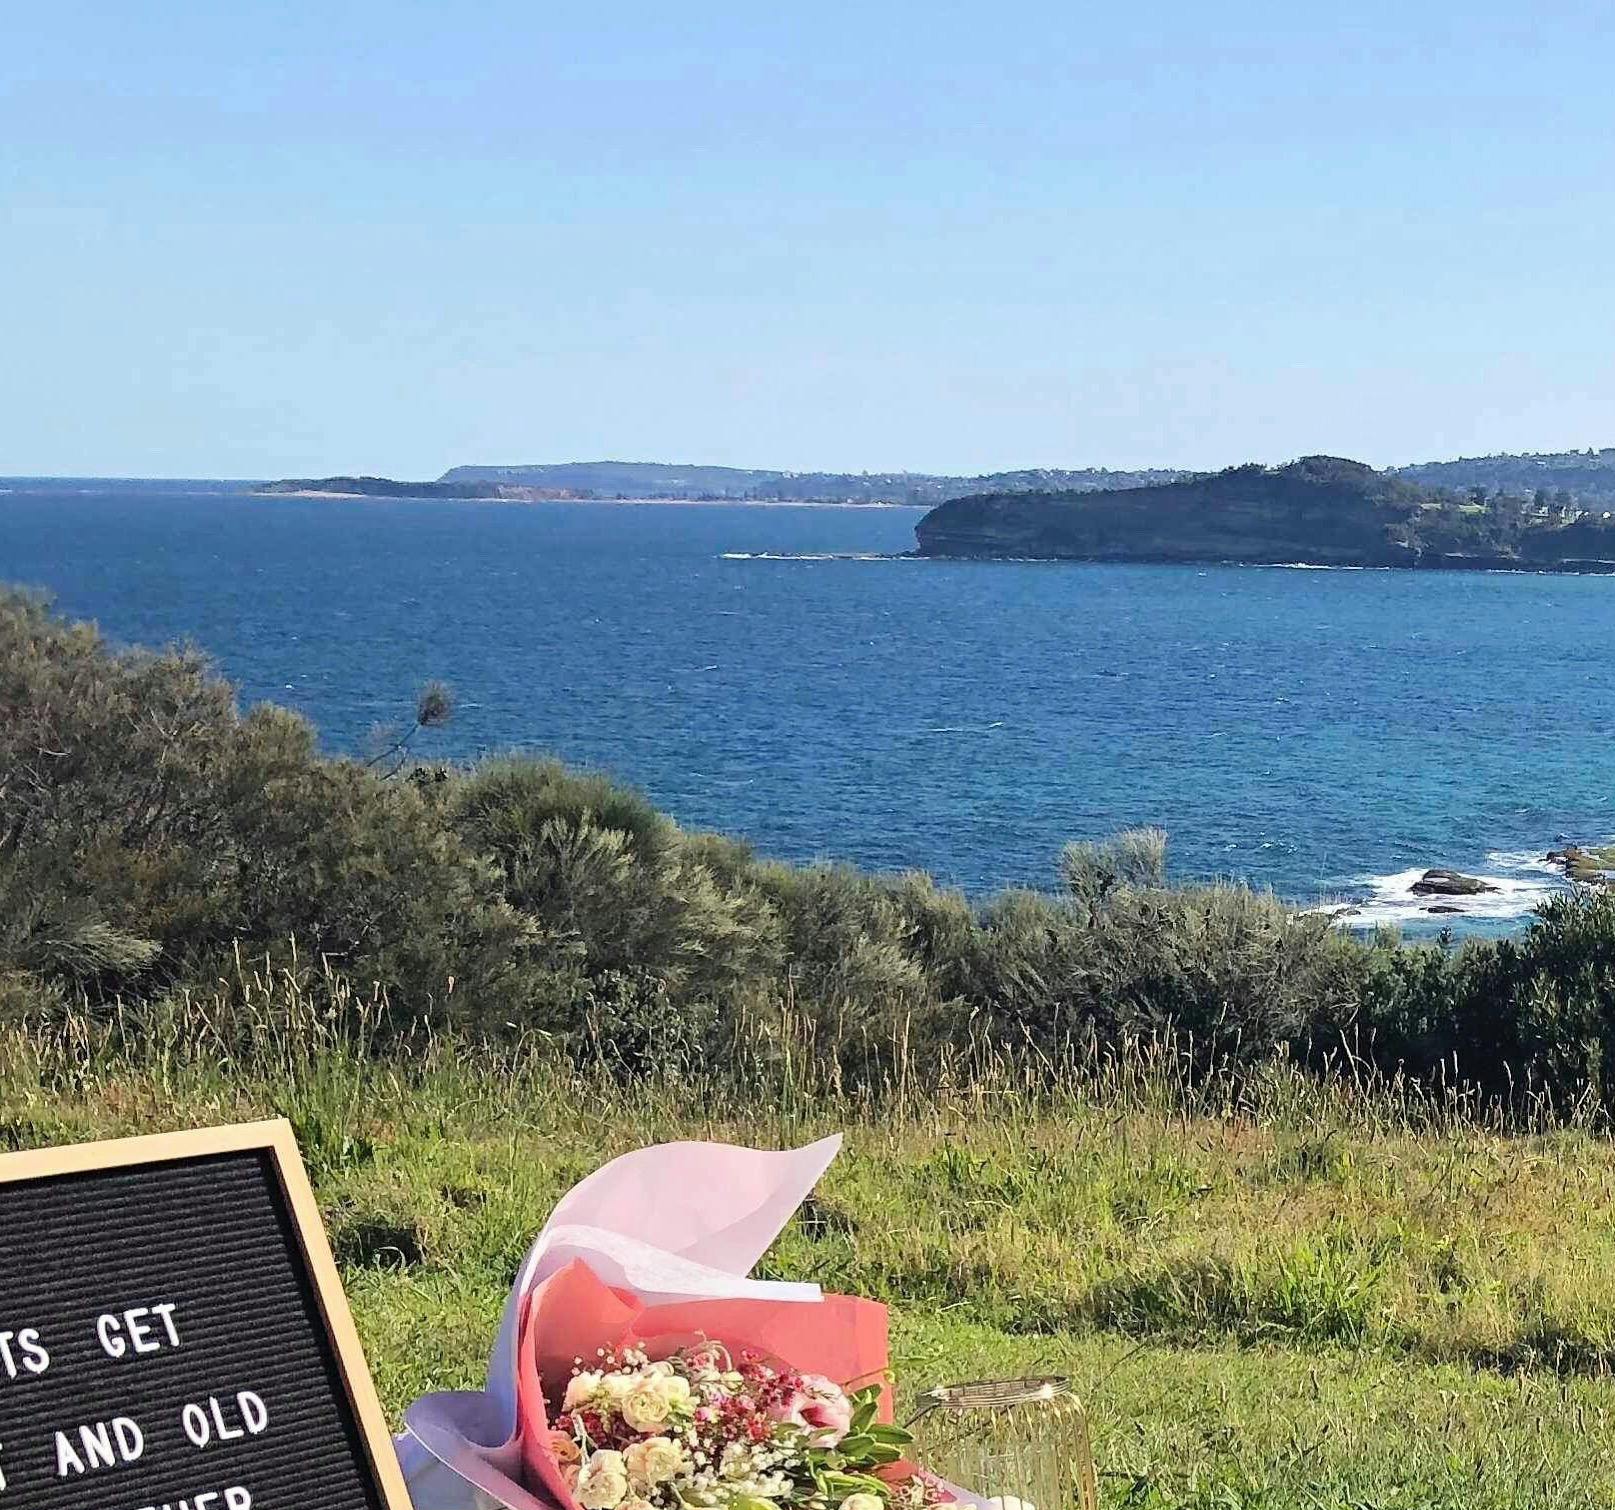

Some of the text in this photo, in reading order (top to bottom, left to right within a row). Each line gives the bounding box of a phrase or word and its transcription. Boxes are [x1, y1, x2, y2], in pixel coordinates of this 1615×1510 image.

[96, 1303, 180, 1358] GET
[54, 1416, 144, 1477] AND
[182, 1390, 269, 1449] OLD
